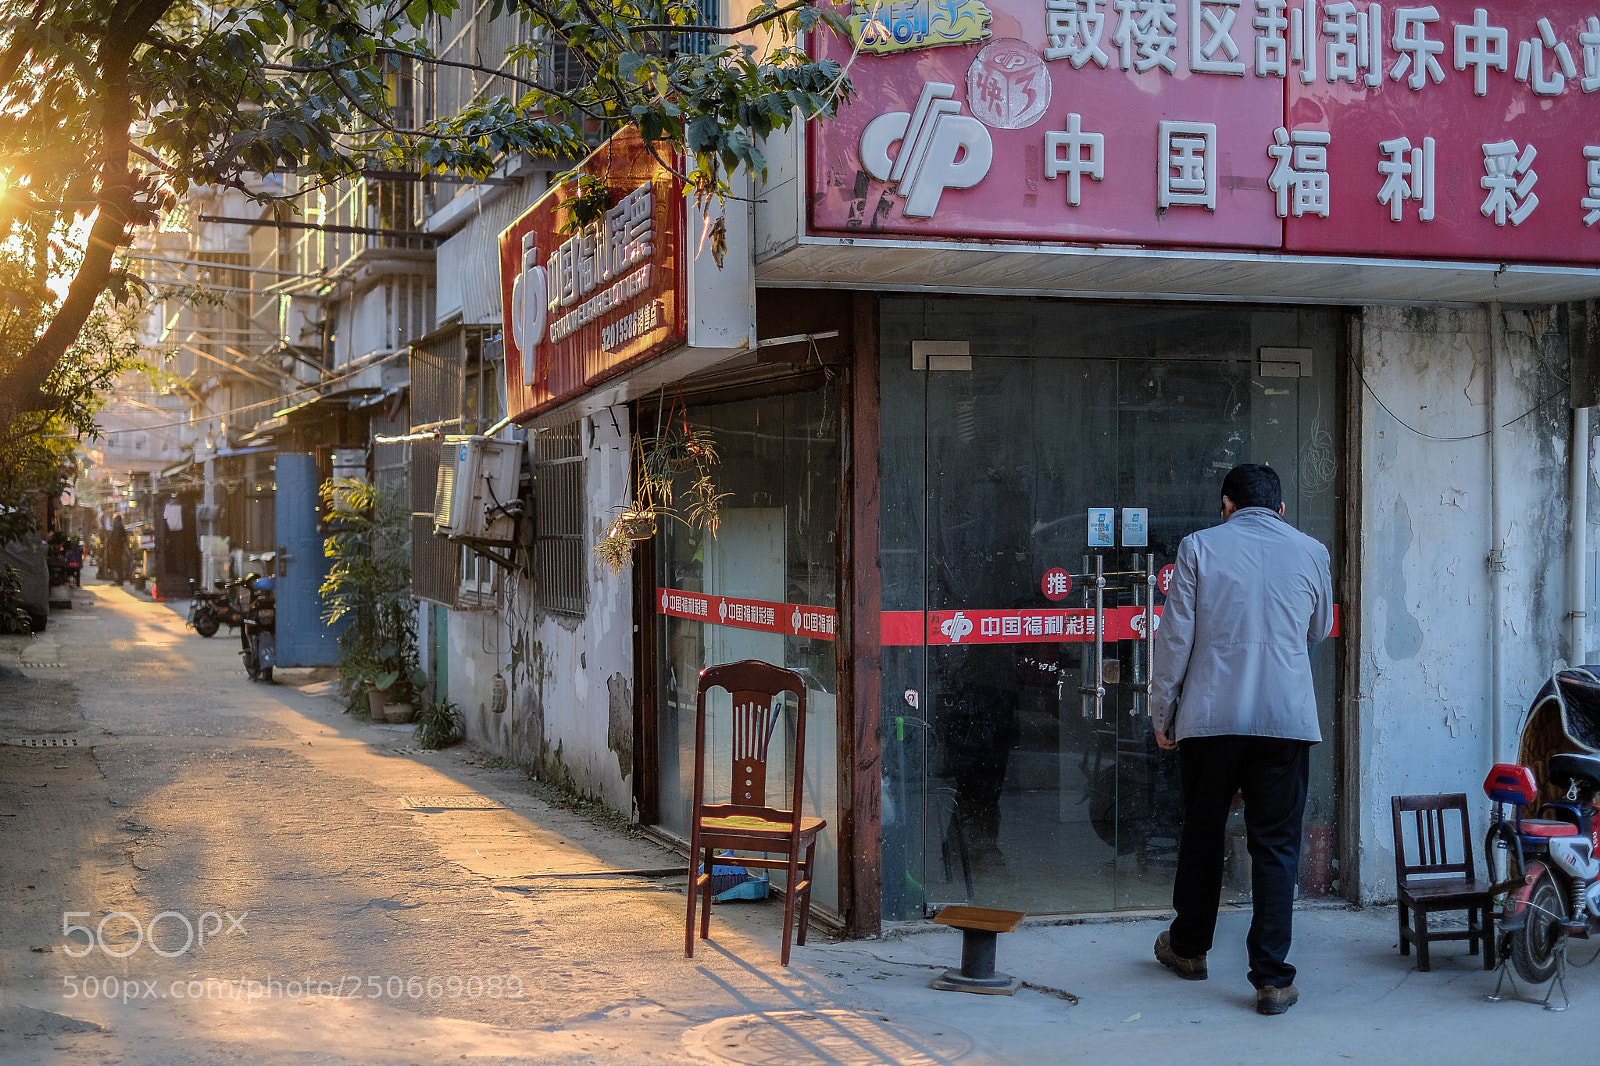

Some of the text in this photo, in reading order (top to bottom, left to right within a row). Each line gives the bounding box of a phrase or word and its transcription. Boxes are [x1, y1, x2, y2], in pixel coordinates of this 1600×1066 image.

[1047, 572, 1068, 596] 推
[669, 595, 708, 617] 中国福利彩票
[728, 603, 775, 626] 中国福利彩票
[803, 612, 836, 636] 中国福利
[980, 615, 1105, 637] 中国福利彩票
